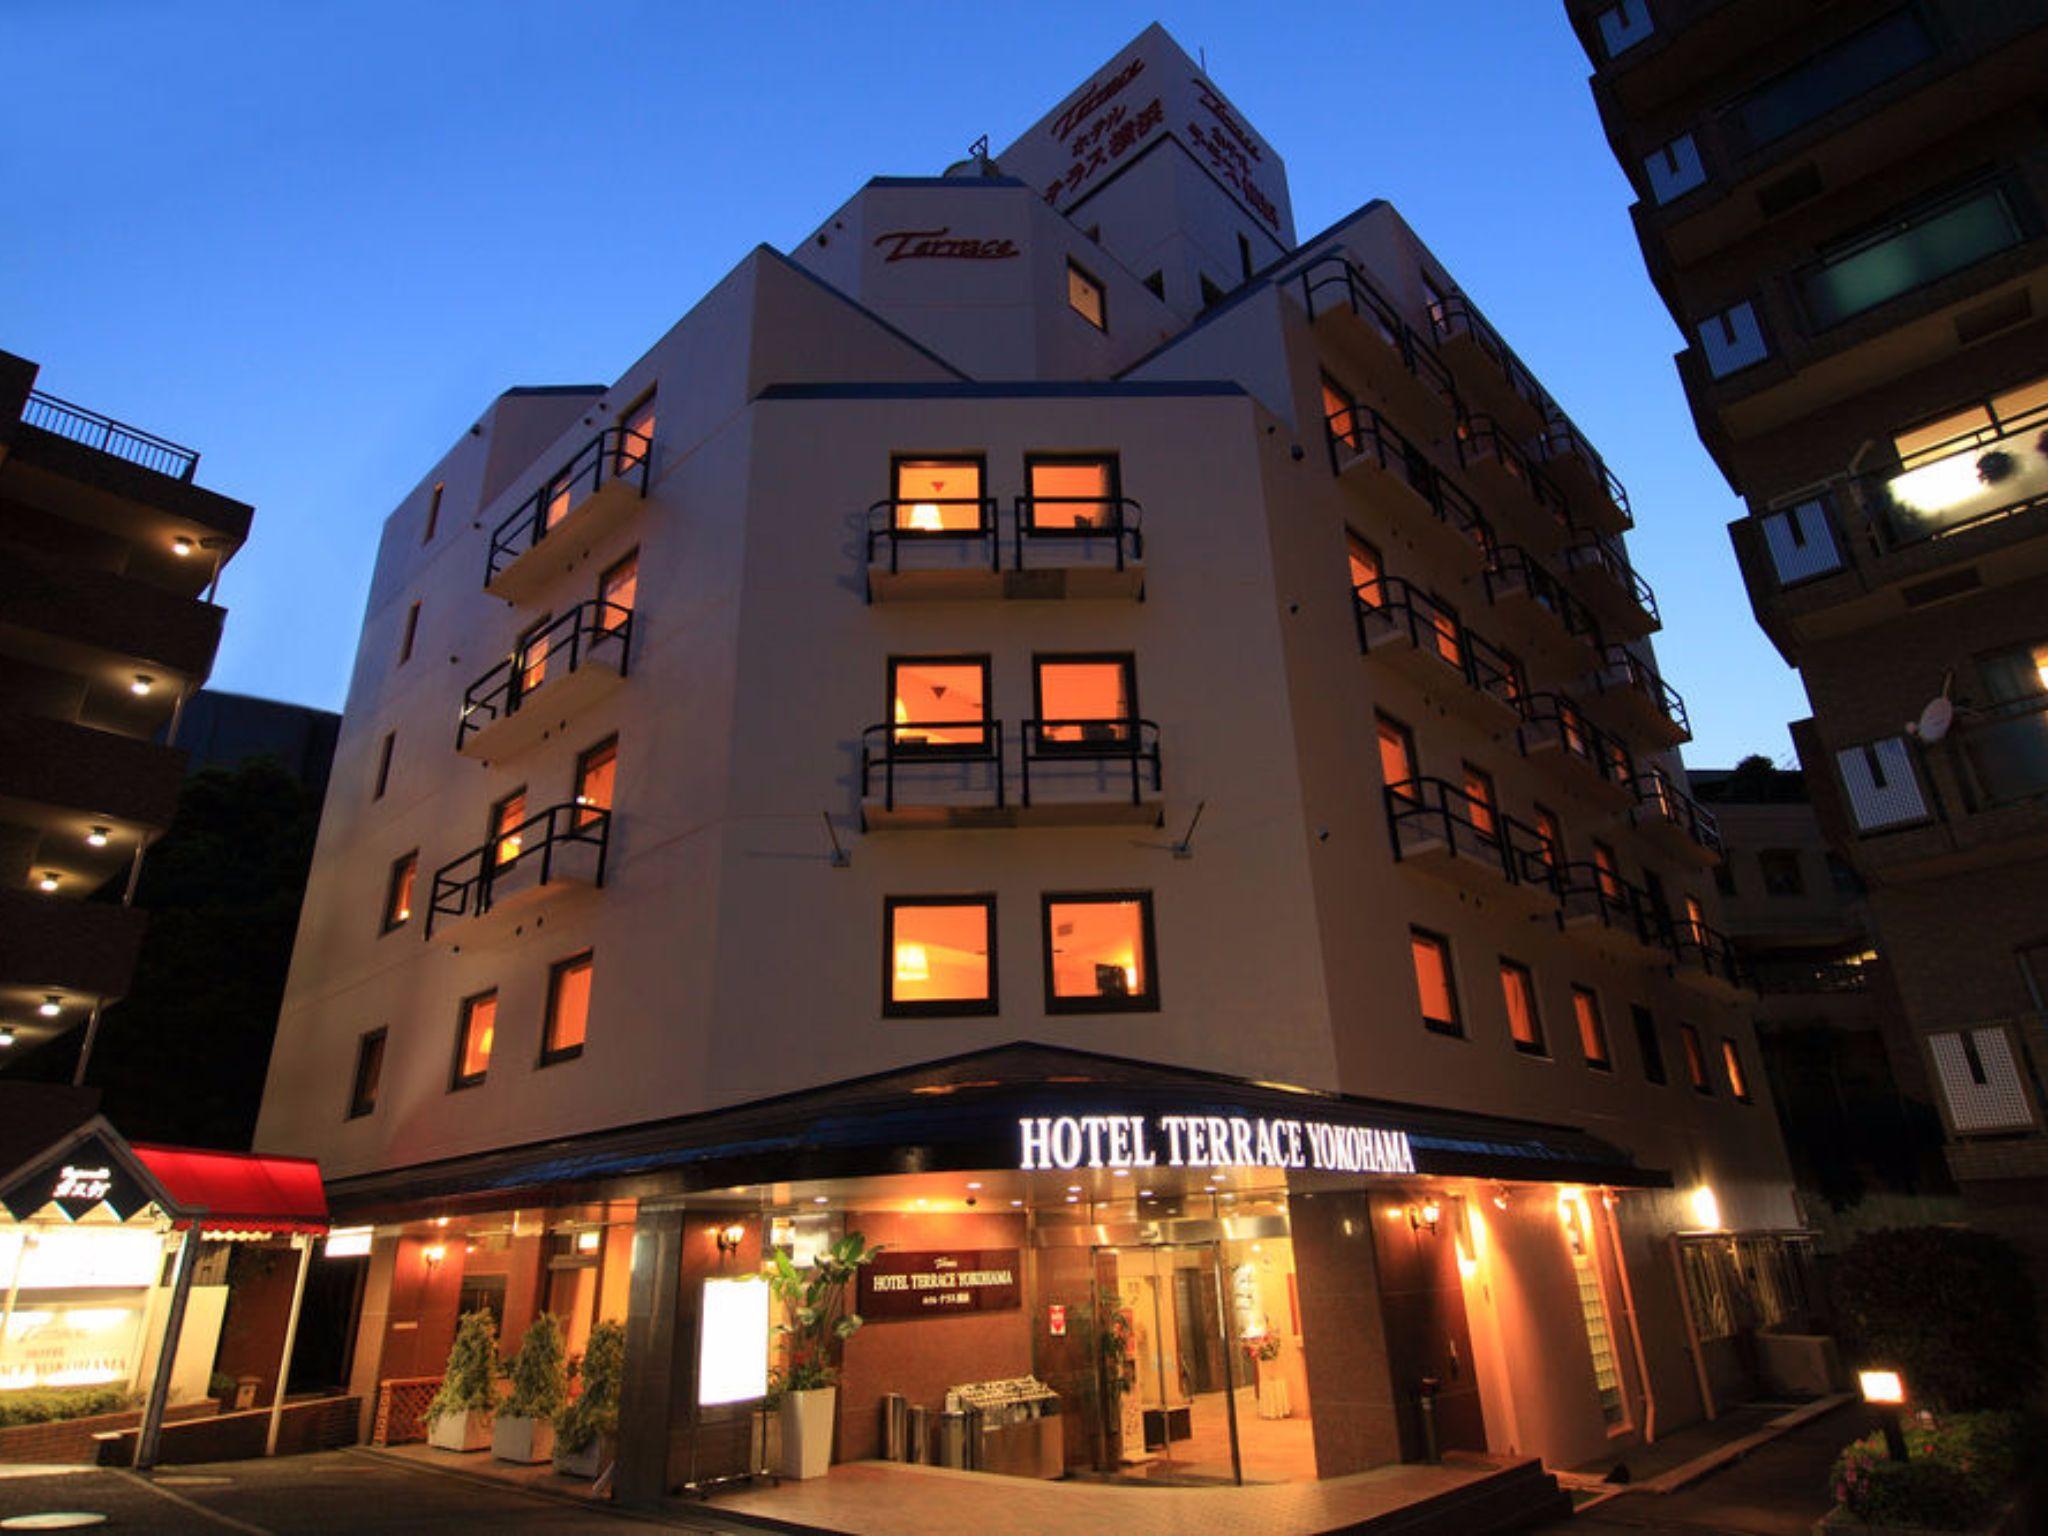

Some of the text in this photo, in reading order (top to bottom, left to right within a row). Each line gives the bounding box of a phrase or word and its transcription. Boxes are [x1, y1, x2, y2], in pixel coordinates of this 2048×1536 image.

[875, 228, 1019, 261] Terrace
[1019, 1116, 1416, 1173] HOTEL TERRACE YOKOHAMA
[873, 1270, 1013, 1291] HOTEL TERRACE YOKOHAMA
